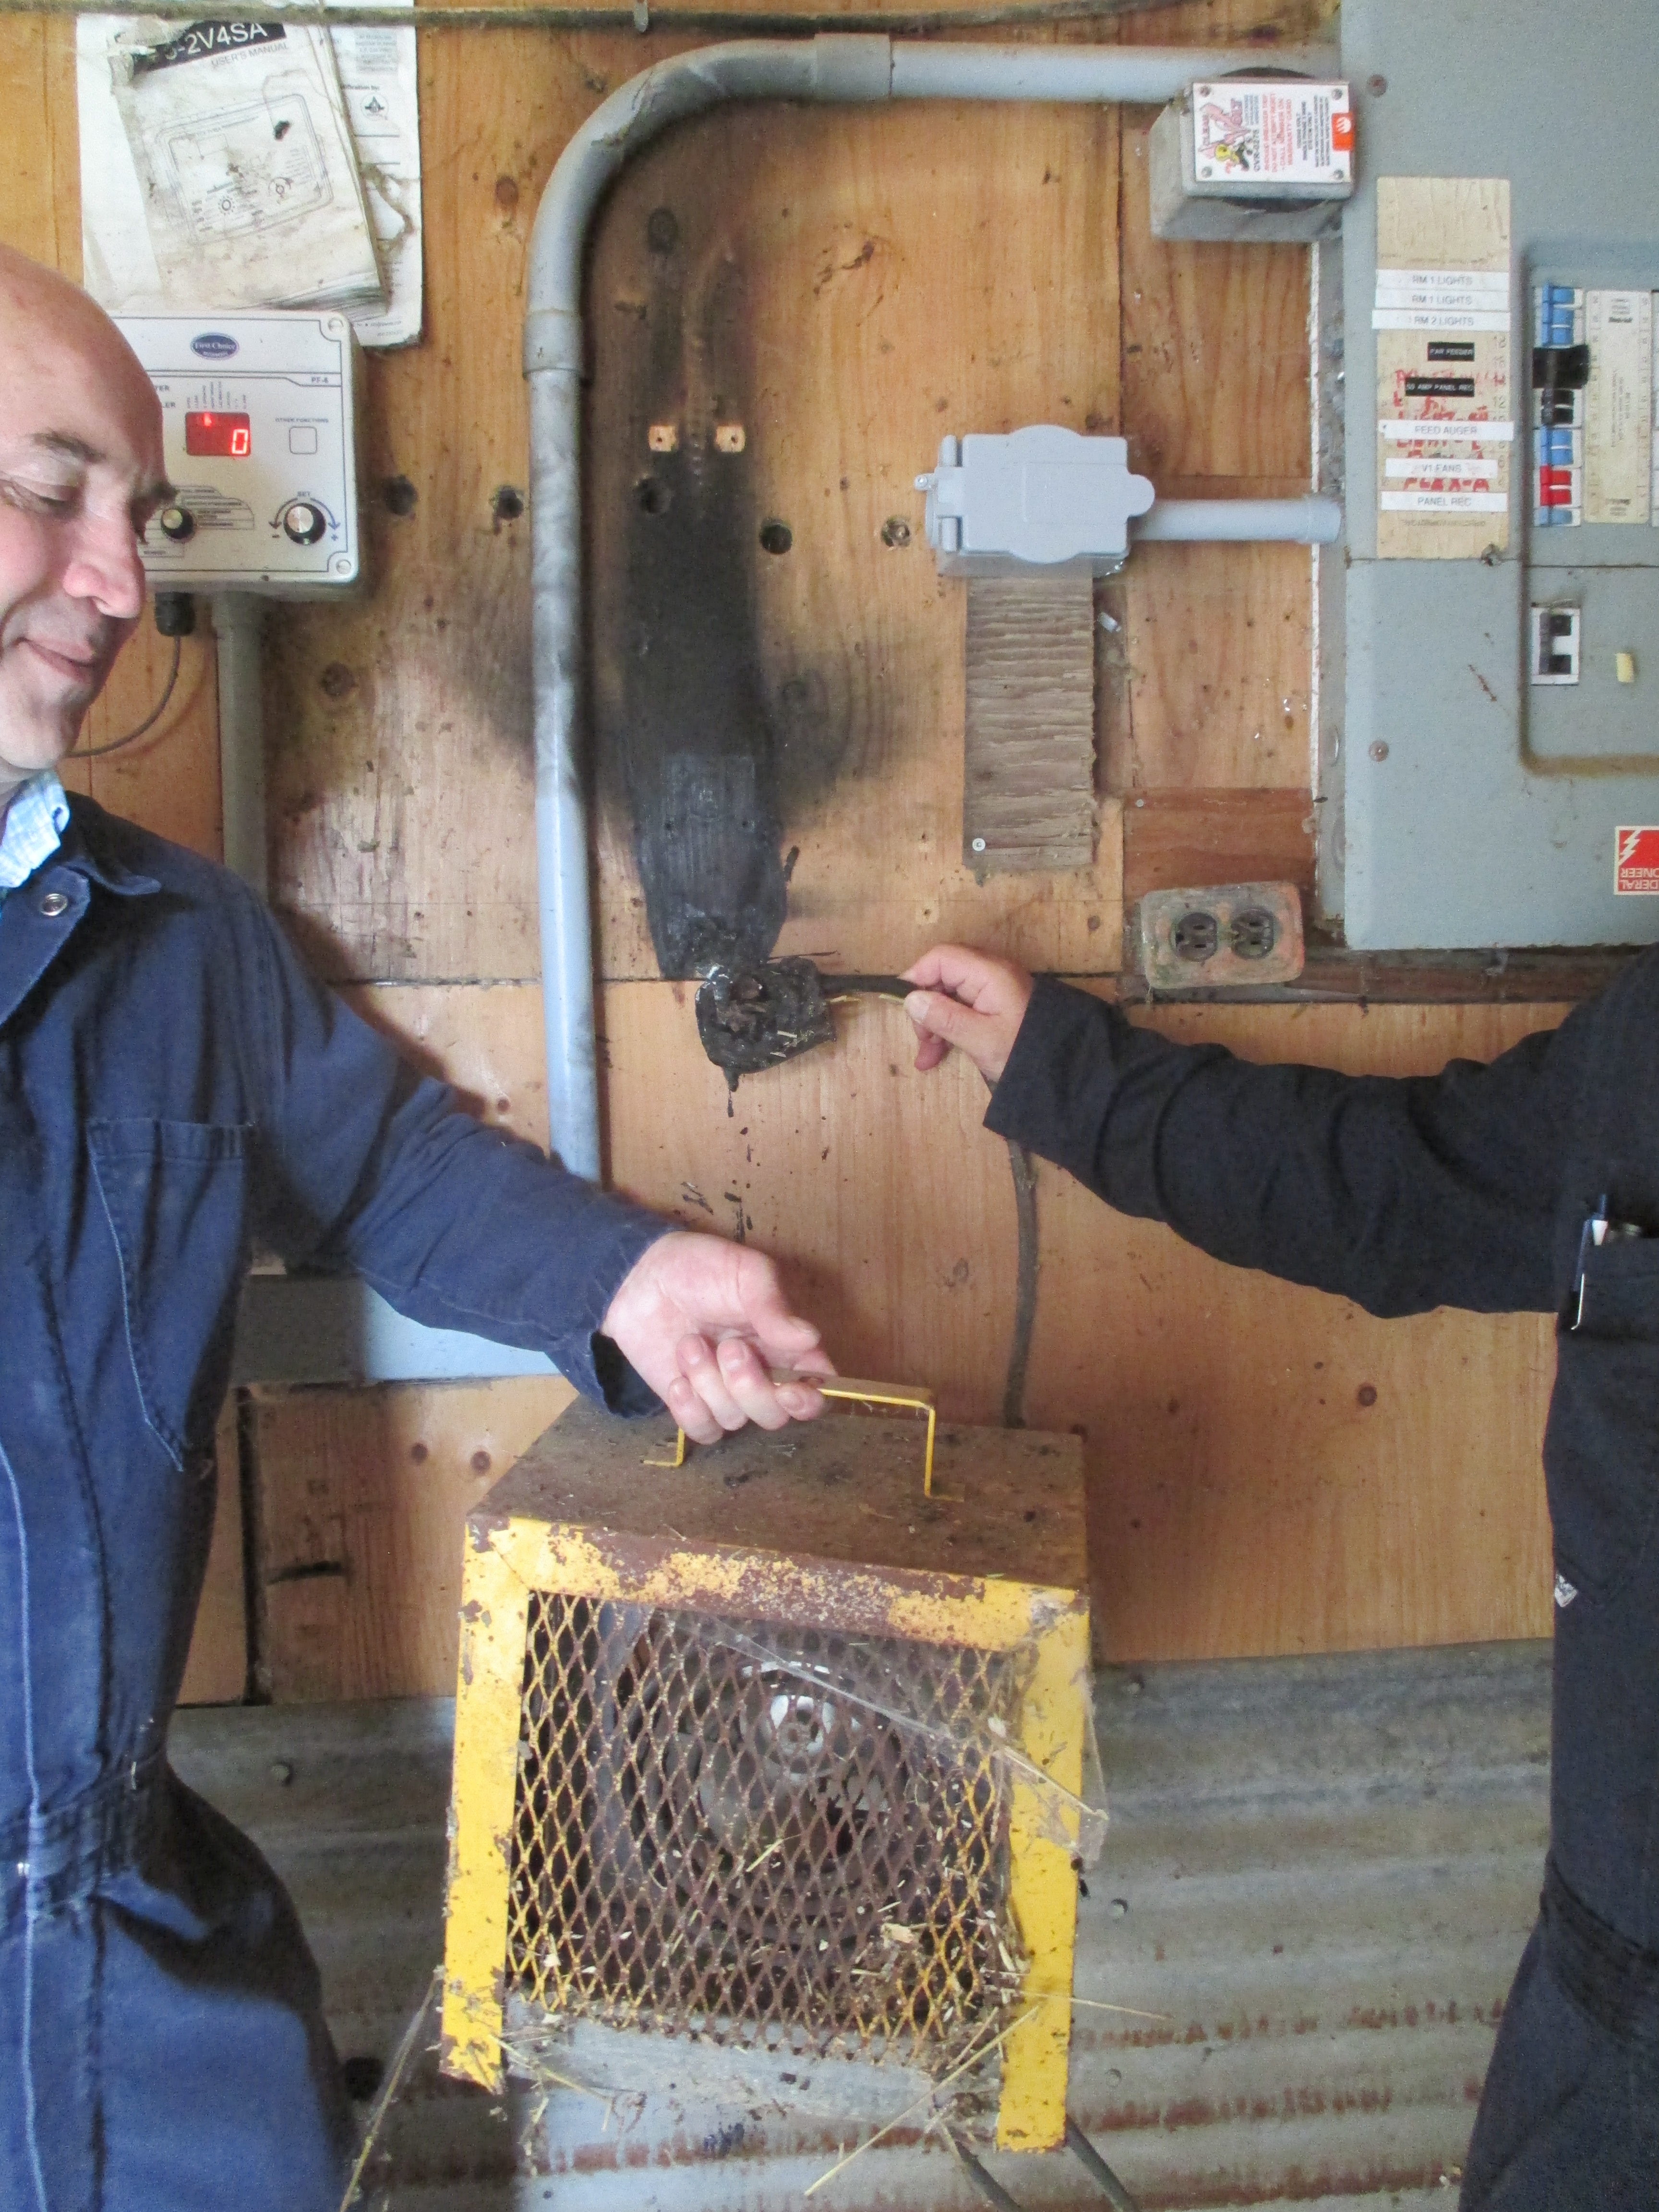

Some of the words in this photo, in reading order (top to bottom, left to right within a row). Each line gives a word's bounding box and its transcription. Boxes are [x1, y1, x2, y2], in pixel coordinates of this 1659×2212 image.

[211, 51, 247, 67] USER'S
[249, 42, 289, 59] MANUAL
[1412, 275, 1427, 283] RM
[1430, 276, 1434, 284] 1
[1437, 276, 1473, 286] LIGHTS
[1412, 295, 1427, 303] RM
[1430, 295, 1434, 303] 1
[1437, 295, 1473, 305] LIGHTS
[1414, 316, 1429, 325] RM
[1431, 316, 1437, 325] 2
[1440, 317, 1474, 326] LIGHTS
[1415, 425, 1441, 434] FEED
[1443, 426, 1478, 435] AUGER
[230, 427, 249, 455] 0
[1422, 464, 1432, 472] V1
[1436, 464, 1462, 473] FANS
[1418, 497, 1448, 506] PANEL
[1451, 498, 1472, 506] REC
